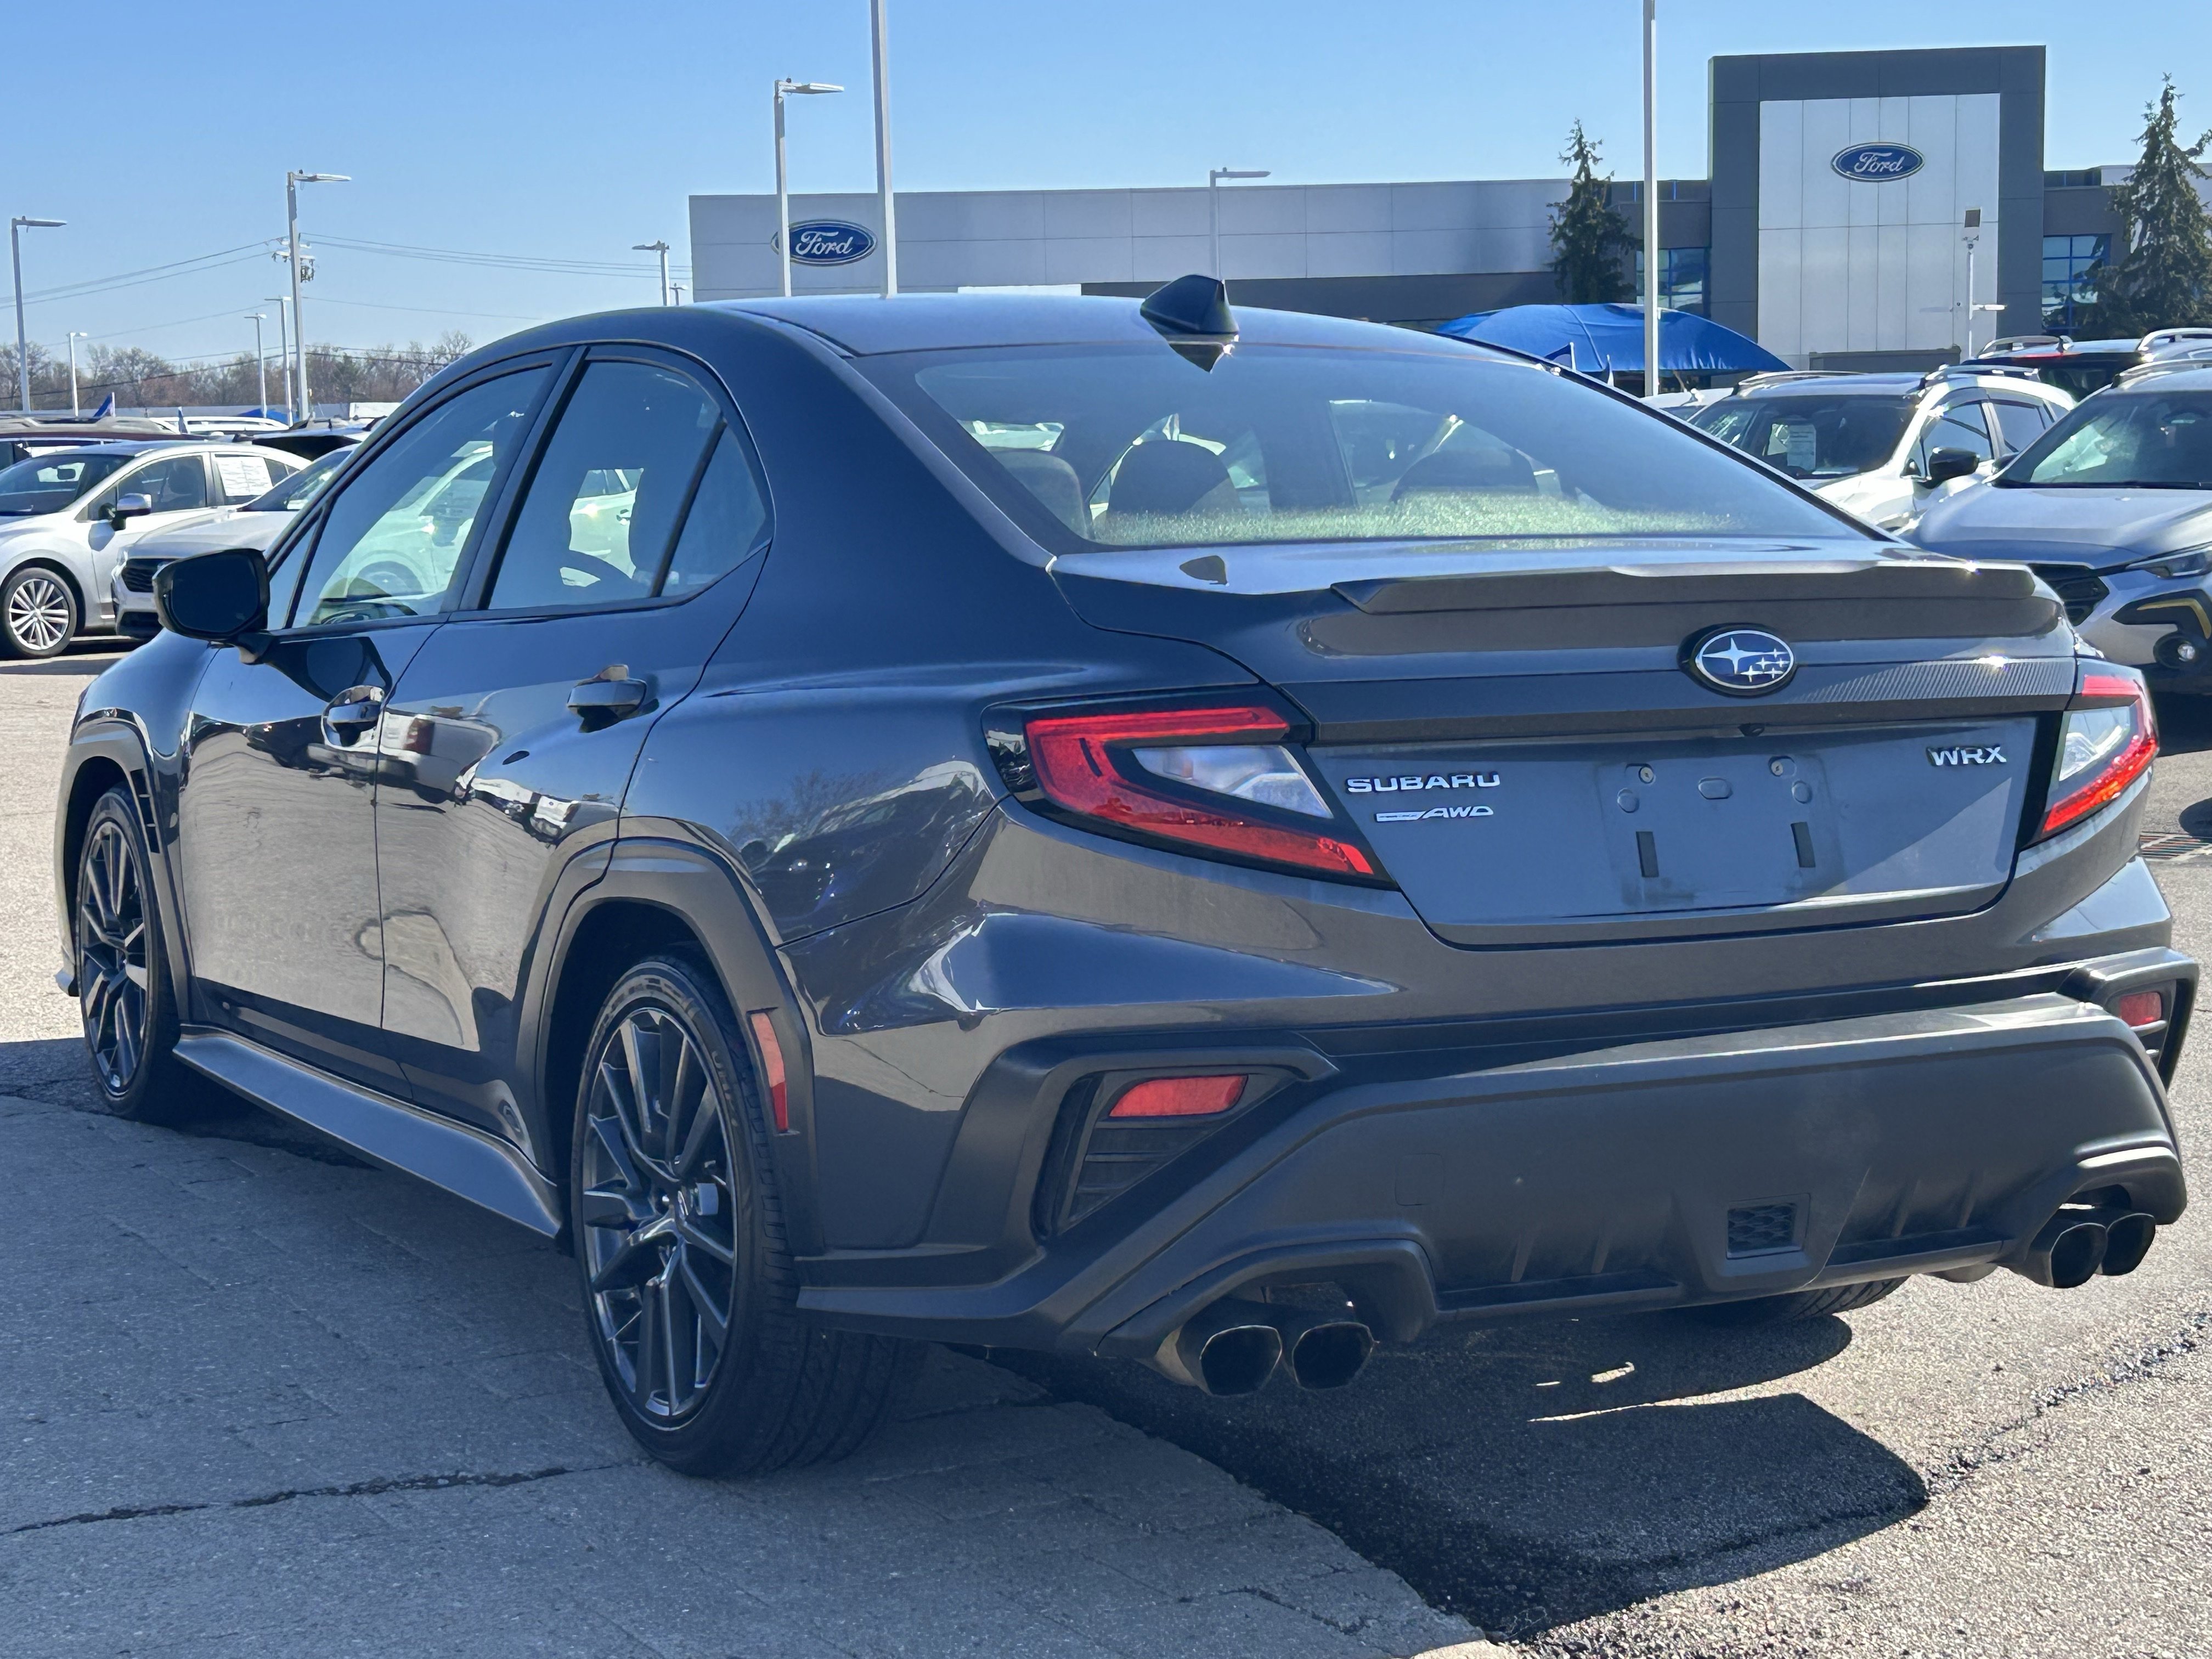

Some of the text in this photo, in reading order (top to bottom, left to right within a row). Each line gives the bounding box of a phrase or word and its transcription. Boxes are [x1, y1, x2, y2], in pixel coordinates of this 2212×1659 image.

[1854, 152, 1905, 173] Ford
[795, 230, 854, 255] Ford
[1927, 746, 2007, 766] WRX
[1347, 772, 1500, 793] SUBARU
[1422, 806, 1494, 819] AWD
